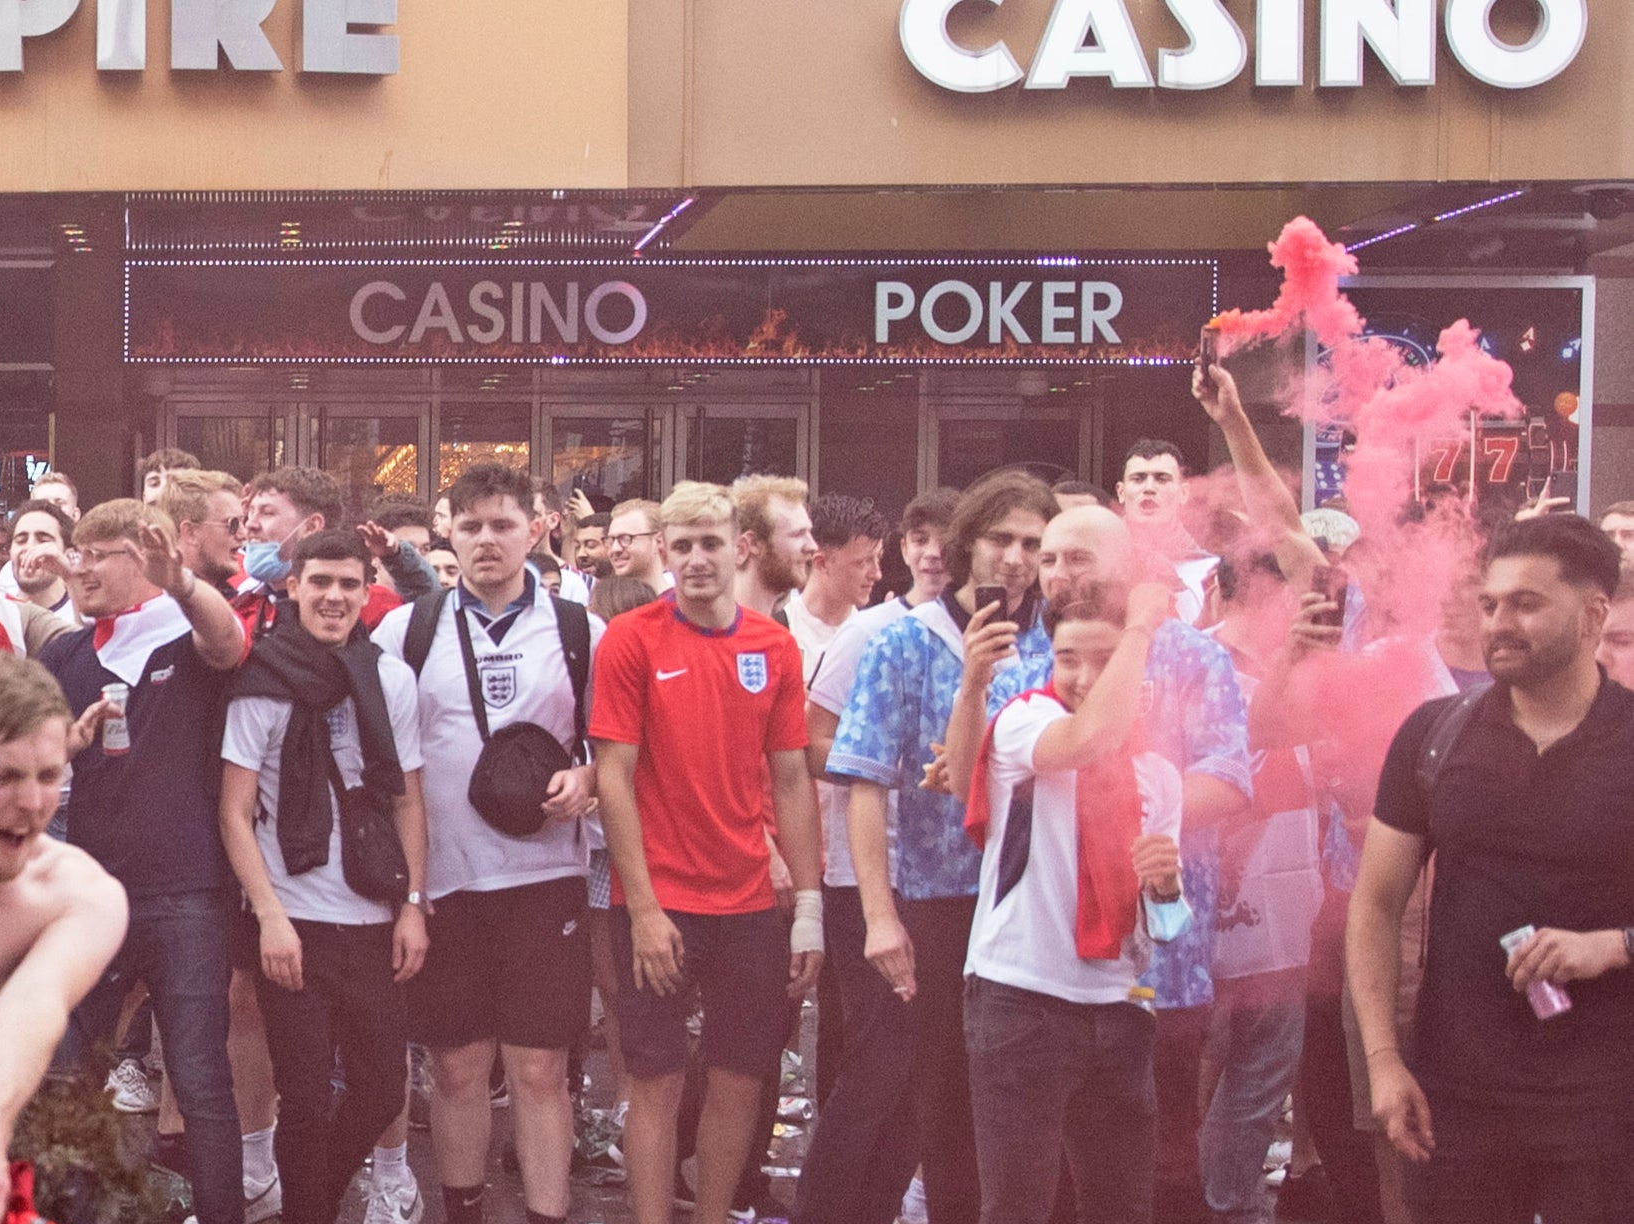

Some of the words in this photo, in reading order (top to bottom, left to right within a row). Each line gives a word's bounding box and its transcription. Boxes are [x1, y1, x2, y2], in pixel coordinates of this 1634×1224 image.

[899, 0, 1588, 93] CASINO
[349, 280, 648, 345] CASINO
[875, 280, 1124, 344] POKER
[1484, 437, 1518, 483] 7
[476, 653, 523, 664] UMBRO
